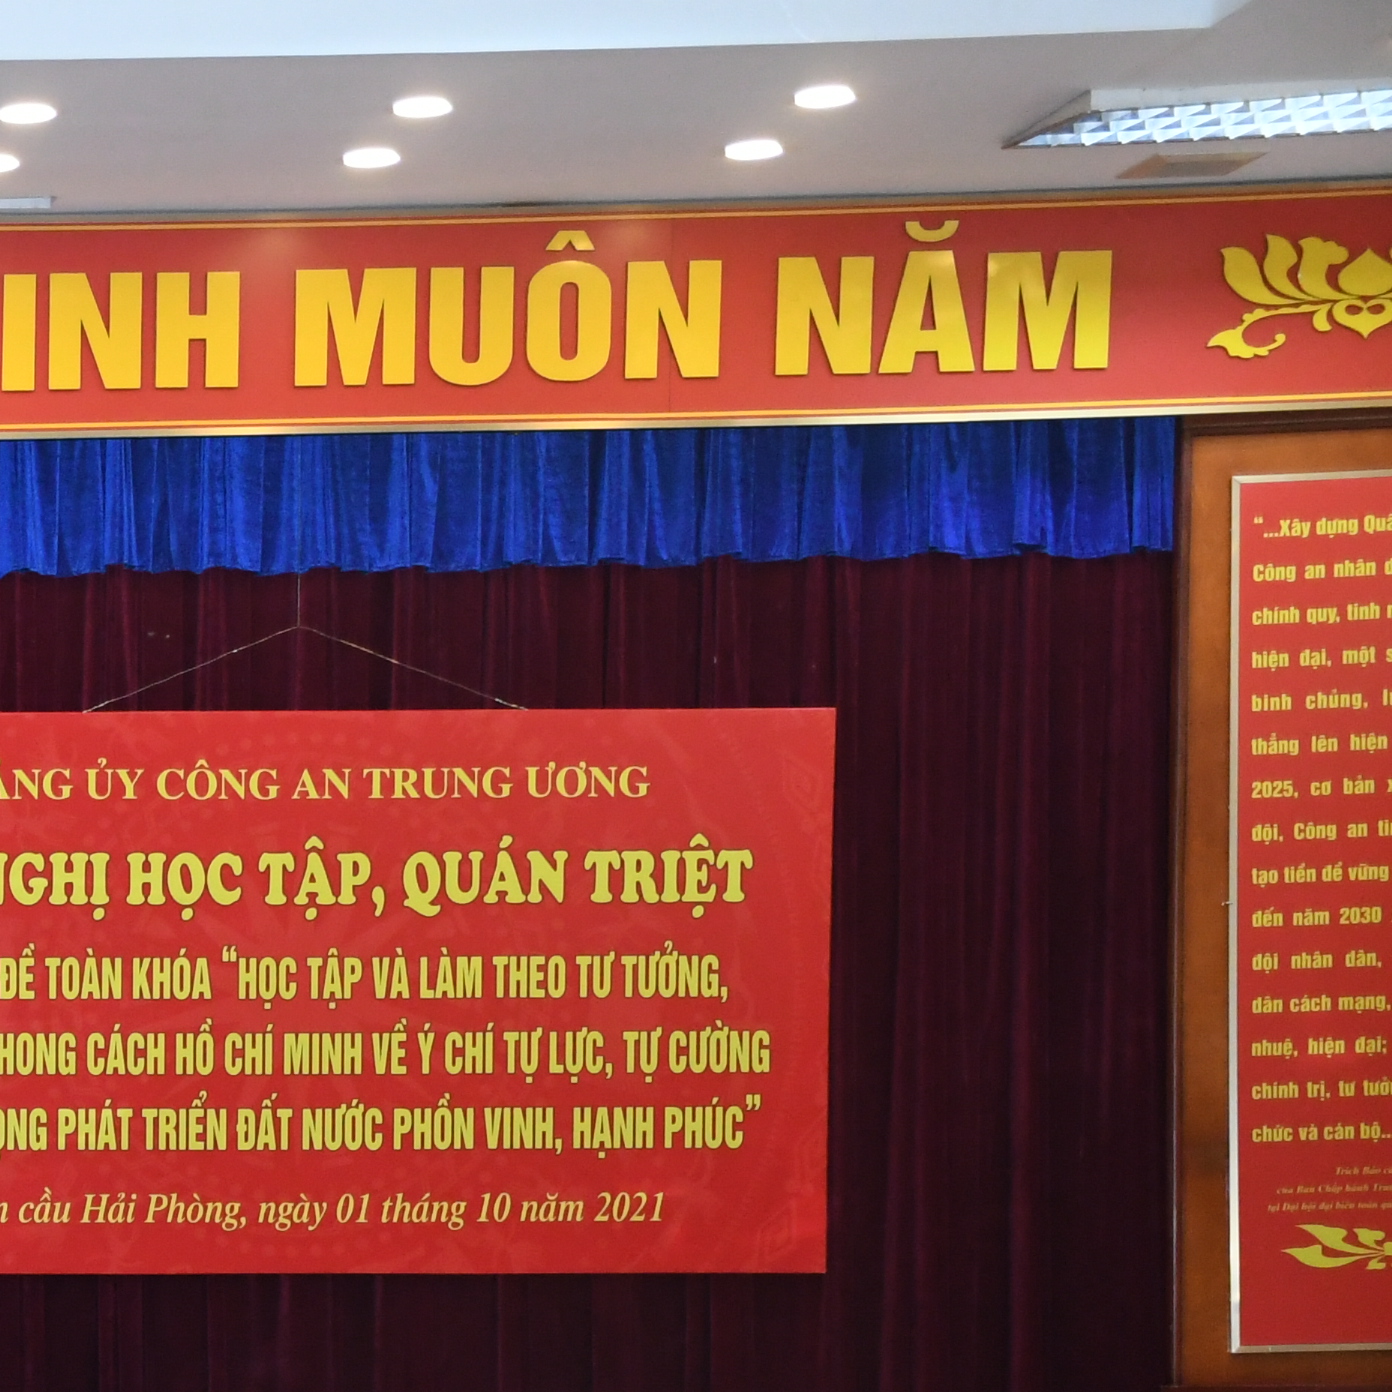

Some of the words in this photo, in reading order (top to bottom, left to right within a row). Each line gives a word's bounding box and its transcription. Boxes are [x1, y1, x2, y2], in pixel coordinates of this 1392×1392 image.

[294, 230, 723, 386] MUÔN
[775, 221, 1113, 374] NĂM
[1316, 518, 1358, 538] dựng
[1253, 564, 1296, 582] Công
[1305, 565, 1325, 579] an
[1334, 559, 1376, 577] nhân
[1252, 607, 1300, 625] chính
[1307, 608, 1340, 624] quy,
[1347, 603, 1380, 620] tinh
[1252, 651, 1289, 671] hiện
[1300, 649, 1331, 669] đại,
[1343, 646, 1375, 667] một
[1252, 694, 1291, 711] binh
[1306, 689, 1368, 709] chủng,
[1252, 733, 1299, 755] thẳng
[1312, 735, 1338, 752] lên
[1350, 733, 1387, 753] hiện
[85, 758, 144, 799] ỦY
[157, 759, 280, 800] CÔNG
[292, 769, 351, 799] AN
[363, 767, 513, 798] TRUNG
[526, 762, 650, 797] ƯƠNG
[1252, 781, 1298, 798] 2025,
[1311, 781, 1331, 796] cơ
[1343, 775, 1374, 794] bản
[1252, 824, 1283, 844] đội,
[1294, 822, 1336, 840] Công
[1348, 823, 1367, 837] an
[127, 853, 242, 920] HỌC
[259, 836, 384, 920] TẬP,
[403, 835, 568, 916] QUÁN
[584, 833, 753, 918] TRIỆT
[1252, 868, 1278, 887] tạo
[1348, 864, 1389, 881] vững
[1252, 907, 1283, 927] đến
[1293, 909, 1329, 925] năm
[1340, 907, 1381, 924] 2030
[1252, 953, 1278, 973] đội
[1291, 951, 1332, 969] nhân
[1346, 950, 1381, 967] dân,
[45, 948, 122, 999] TOÀN
[133, 948, 211, 999] KHÓA
[307, 948, 362, 1009] TẬP
[372, 948, 409, 998] VÀ
[420, 947, 482, 998] LÀM
[493, 956, 565, 998] THEO
[576, 951, 615, 998] TƯ
[621, 941, 727, 1002] TƯỞNG,
[1252, 996, 1283, 1013] dân
[1290, 995, 1331, 1012] cách
[1339, 996, 1390, 1013] mạng,
[87, 1024, 165, 1075] CÁCH
[176, 1018, 214, 1075] HỒ
[225, 1024, 273, 1075] CHÍ
[284, 1033, 362, 1074] MINH
[372, 1018, 406, 1074] VỀ
[418, 1023, 434, 1074] Ý
[445, 1023, 494, 1074] CHÍ
[503, 1027, 542, 1083] TỰ
[549, 1027, 612, 1083] LỰC,
[623, 1027, 662, 1082] TỰ
[669, 1020, 770, 1073] CƯỜNG
[1252, 1039, 1298, 1059] nhuệ,
[1308, 1037, 1345, 1058] hiện
[1355, 1036, 1386, 1056] đại;
[1252, 1082, 1298, 1099] chính
[1307, 1081, 1330, 1101] trị,
[1339, 1081, 1355, 1096] tư
[58, 1099, 133, 1150] PHÁT
[142, 1091, 226, 1150] TRIỂN
[236, 1093, 292, 1150] ĐẤT
[303, 1099, 382, 1150] NƯỚC
[394, 1093, 474, 1150] PHỒN
[484, 1107, 562, 1154] VINH,
[573, 1107, 653, 1158] HẠNH
[1252, 1125, 1293, 1142] chức
[1299, 1124, 1318, 1140] và
[1324, 1123, 1354, 1140] cán
[19, 1187, 71, 1223] cầu
[80, 1193, 136, 1223] Hải
[145, 1193, 246, 1231] Phòng,
[259, 1193, 327, 1231] ngày
[337, 1194, 369, 1223] 01
[382, 1193, 466, 1230] tháng
[477, 1193, 511, 1222] 10
[521, 1193, 583, 1222] năm
[594, 1192, 663, 1222] 2021
